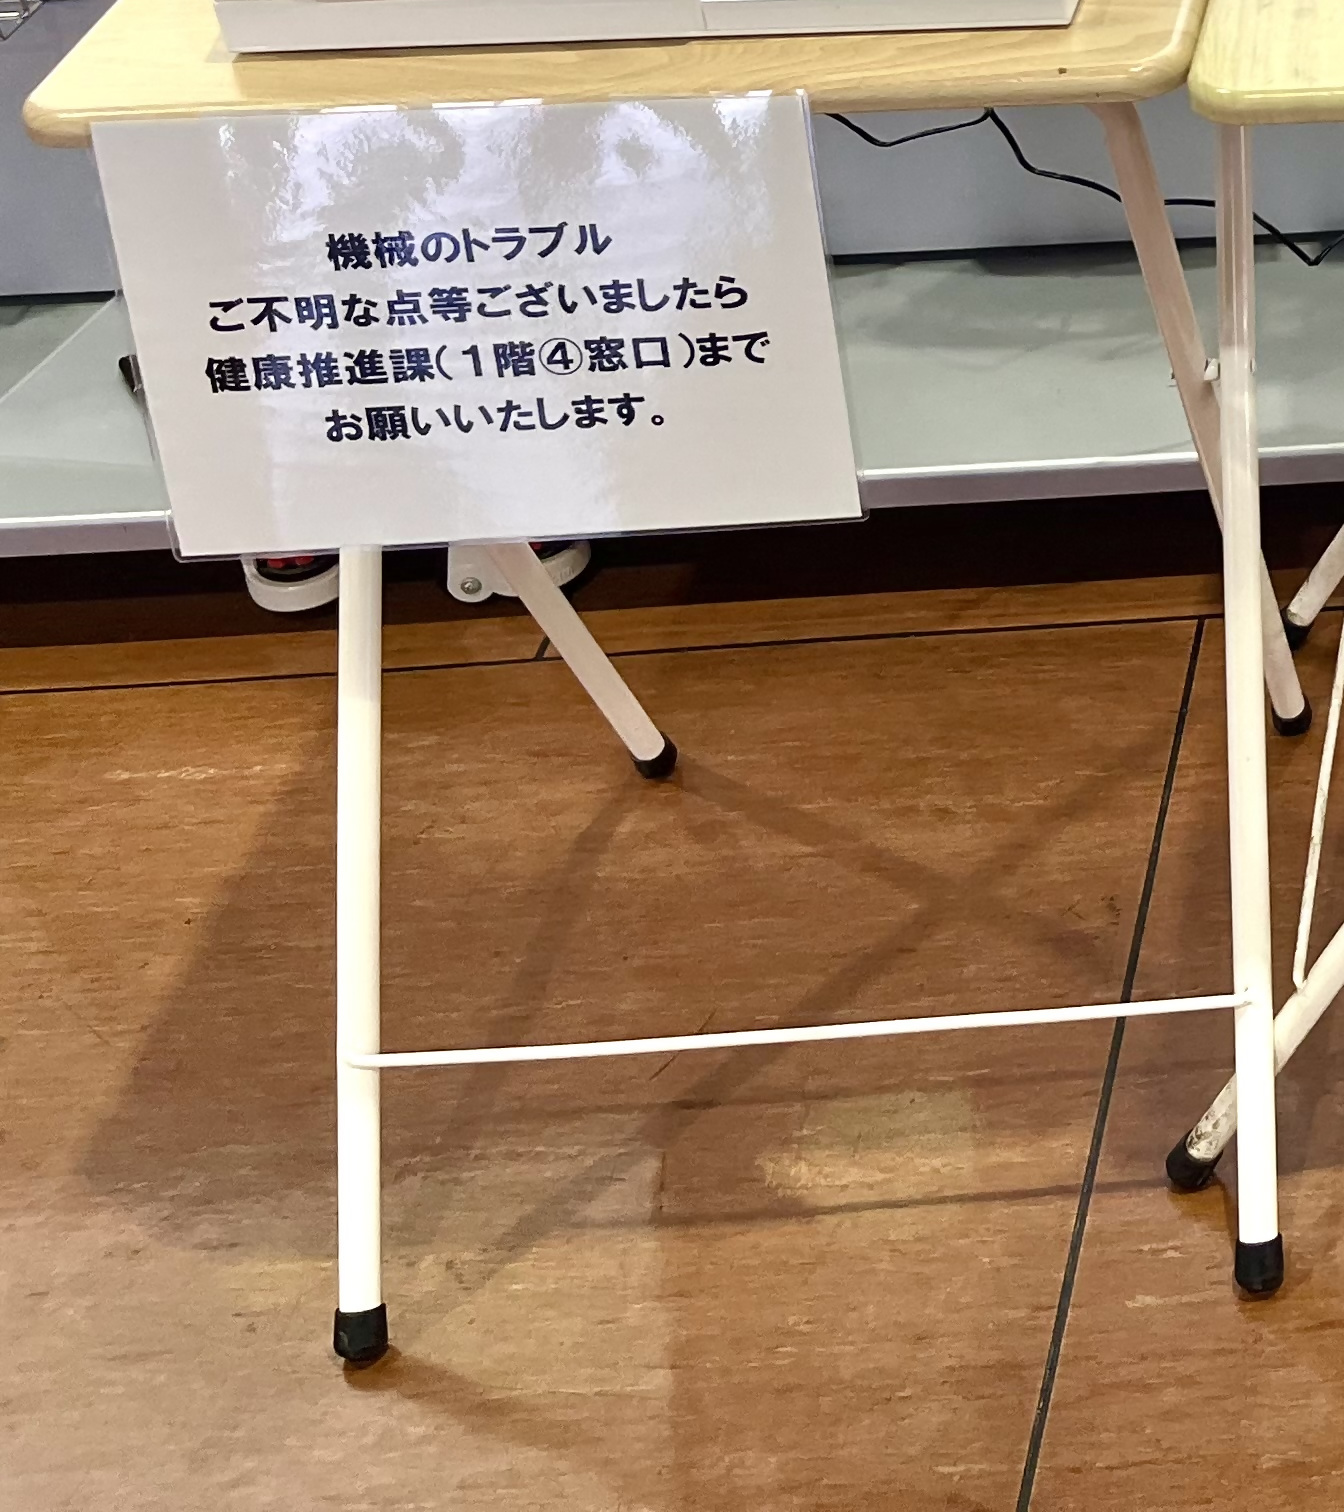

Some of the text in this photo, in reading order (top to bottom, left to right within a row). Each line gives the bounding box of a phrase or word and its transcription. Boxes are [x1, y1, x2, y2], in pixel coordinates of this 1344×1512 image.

[325, 222, 613, 272] 機械のトラブル
[206, 275, 749, 333] ご不明な点等ございましたら
[324, 393, 666, 443] お願いいたします。
